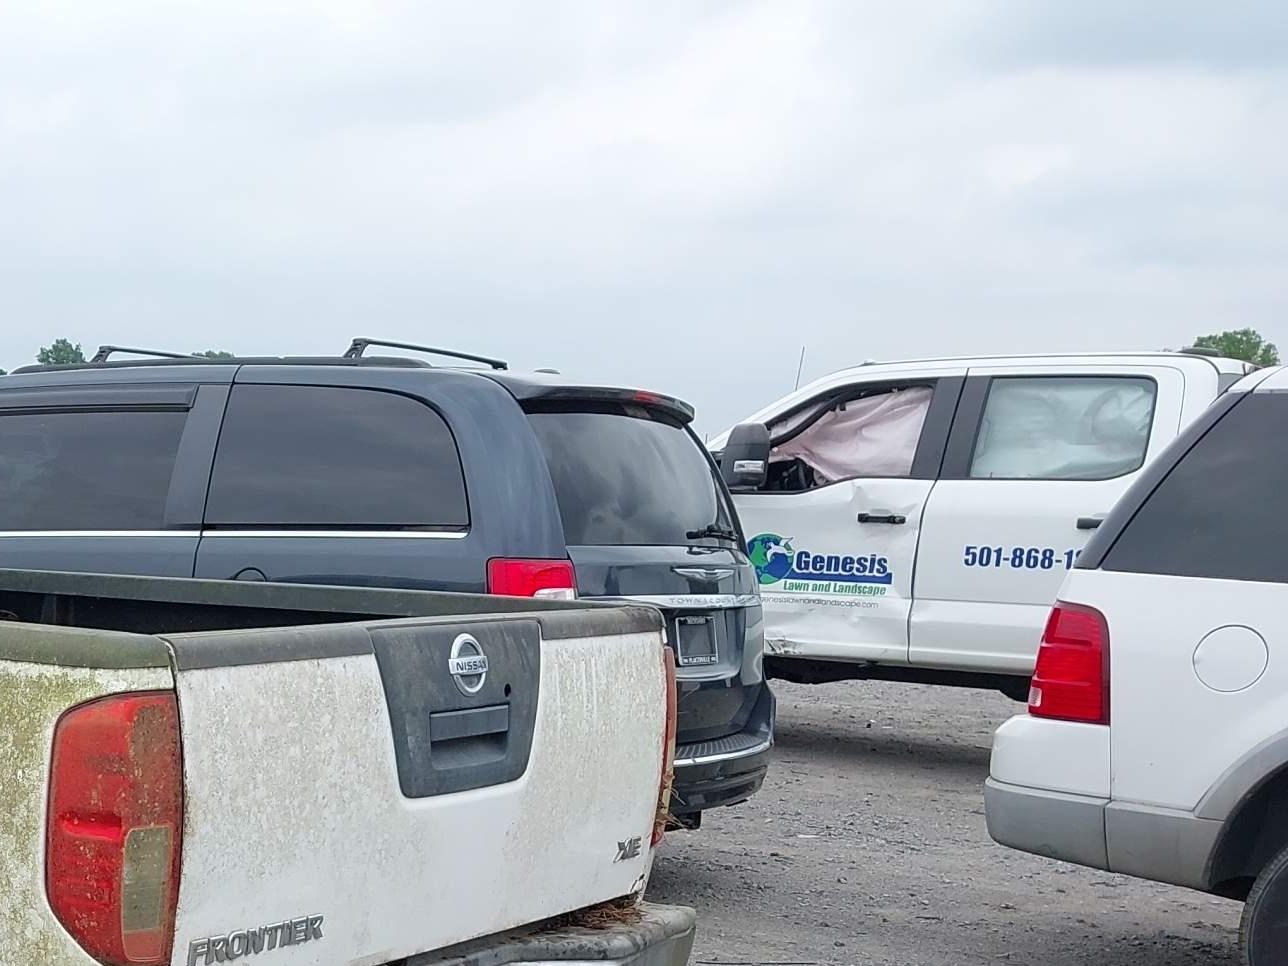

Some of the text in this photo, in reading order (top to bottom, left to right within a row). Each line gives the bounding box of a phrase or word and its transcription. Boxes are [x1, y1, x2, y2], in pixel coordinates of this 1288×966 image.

[795, 550, 889, 575] Genesis
[783, 580, 886, 597] Lawn and Landscape
[455, 660, 487, 672] NISSAN
